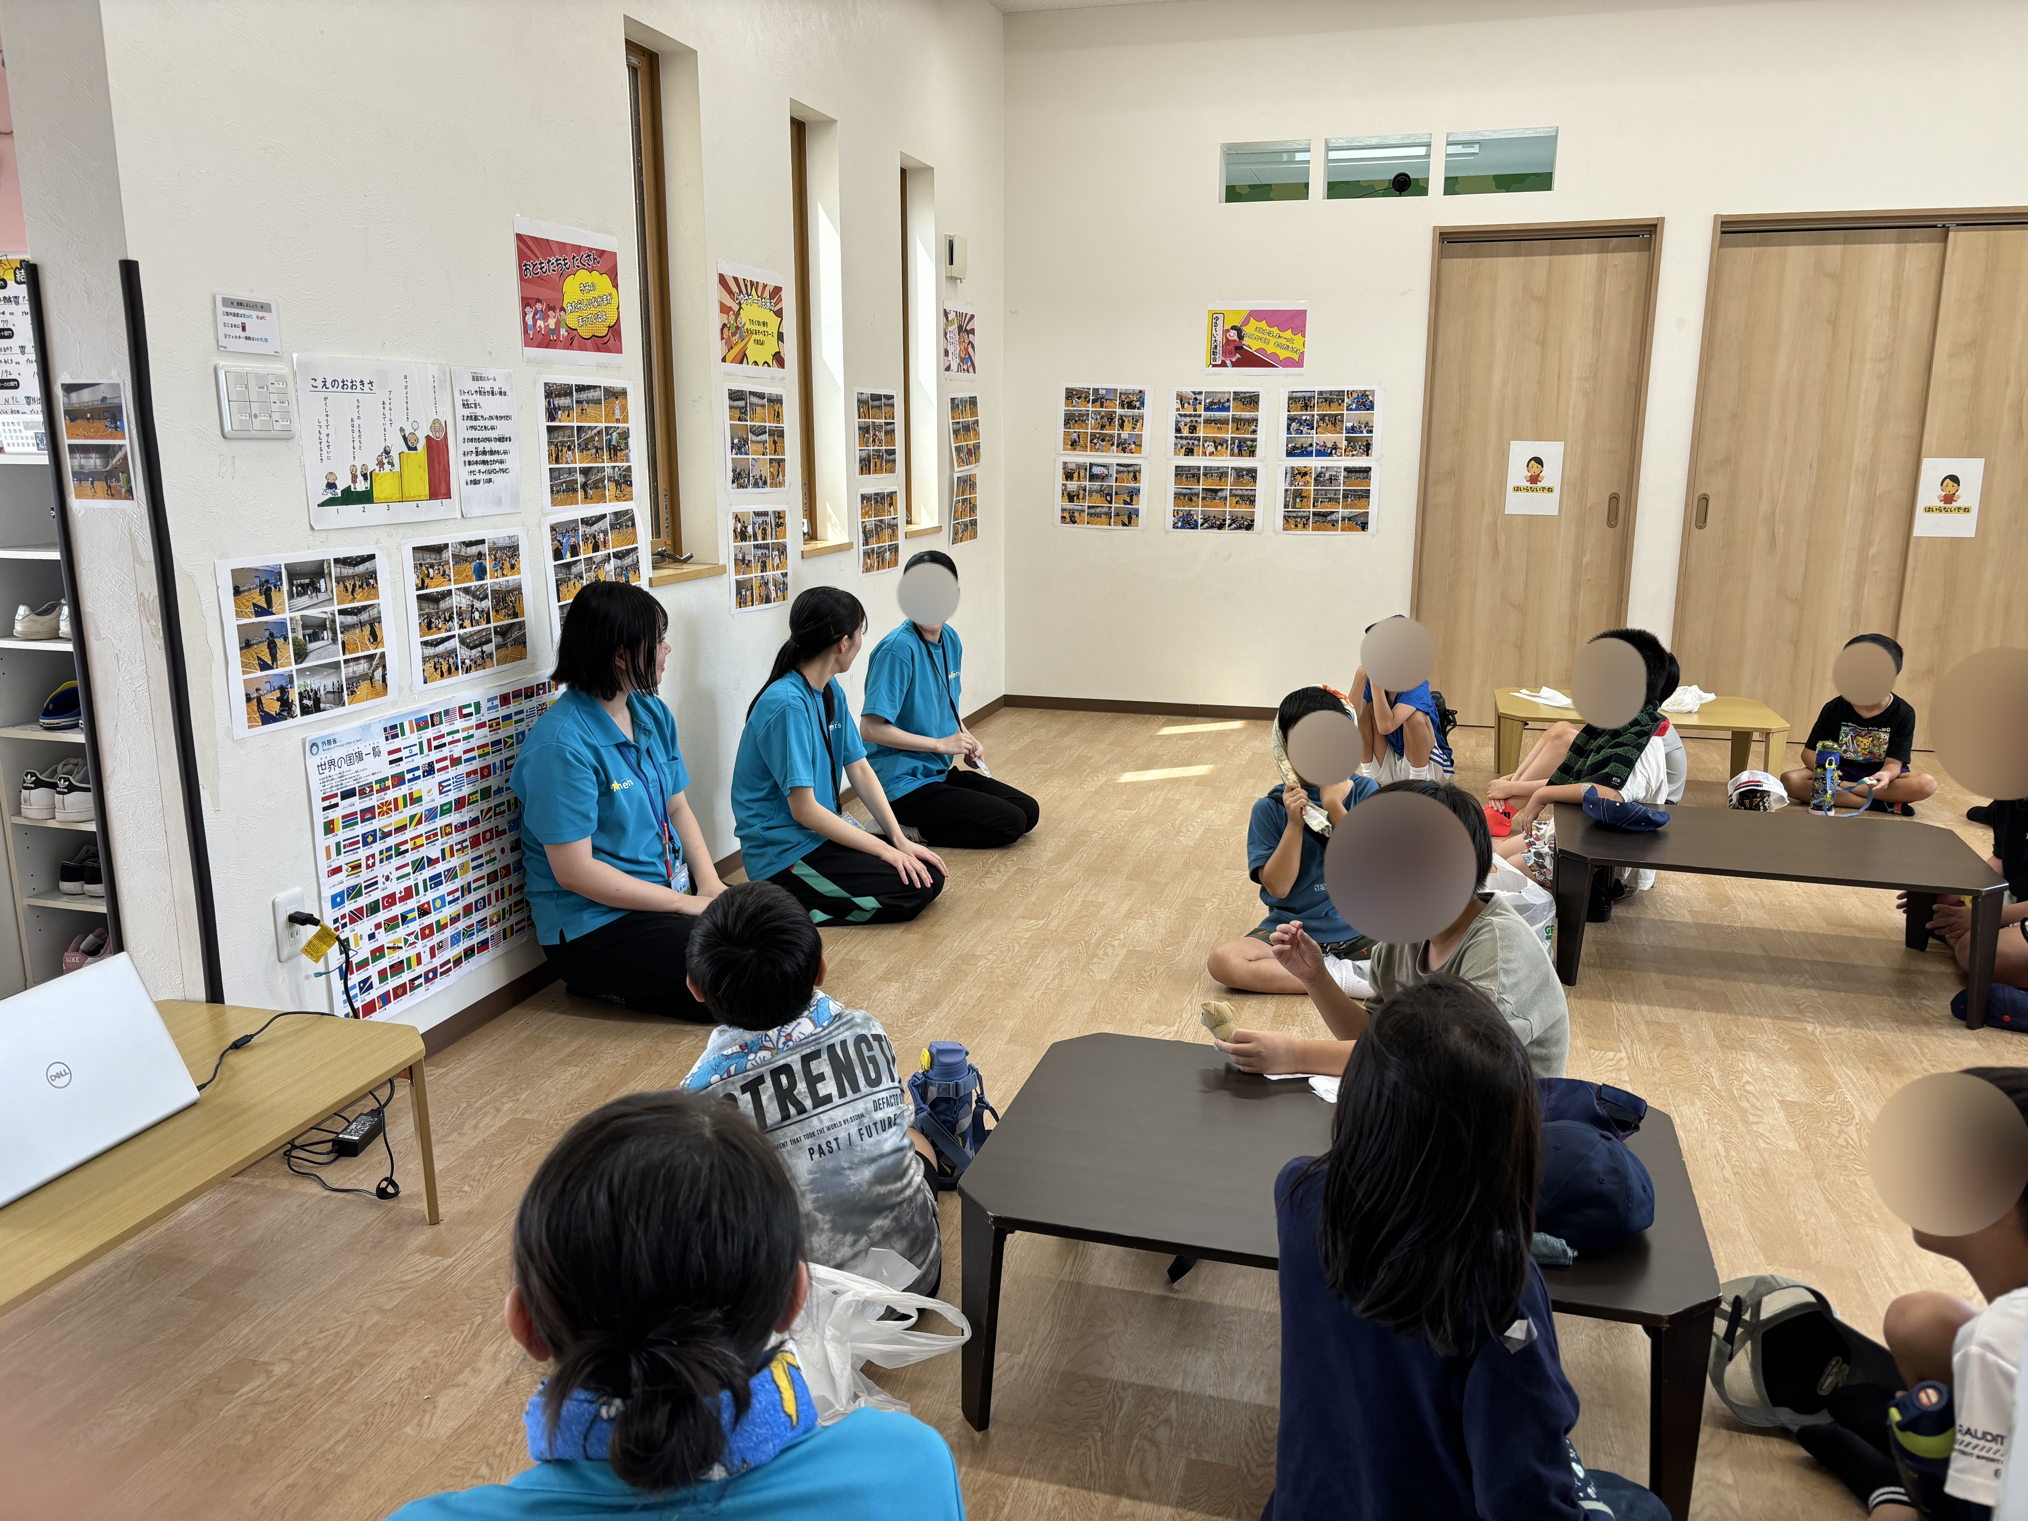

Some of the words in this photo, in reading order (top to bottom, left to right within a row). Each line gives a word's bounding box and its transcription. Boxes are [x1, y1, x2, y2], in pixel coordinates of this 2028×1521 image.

[310, 376, 375, 392] こえのおおきさ
[316, 745, 382, 775] 世界の国旗一覧
[49, 1068, 69, 1082] DELL
[872, 1094, 899, 1112] DEFACTO
[789, 1136, 802, 1146] THAT
[803, 1131, 816, 1141] TOOK
[816, 1127, 826, 1137] THE
[825, 1119, 843, 1133] WORLD
[842, 1117, 850, 1126] BY
[807, 1136, 842, 1162] PAST
[857, 1113, 898, 1142] FUTURE
